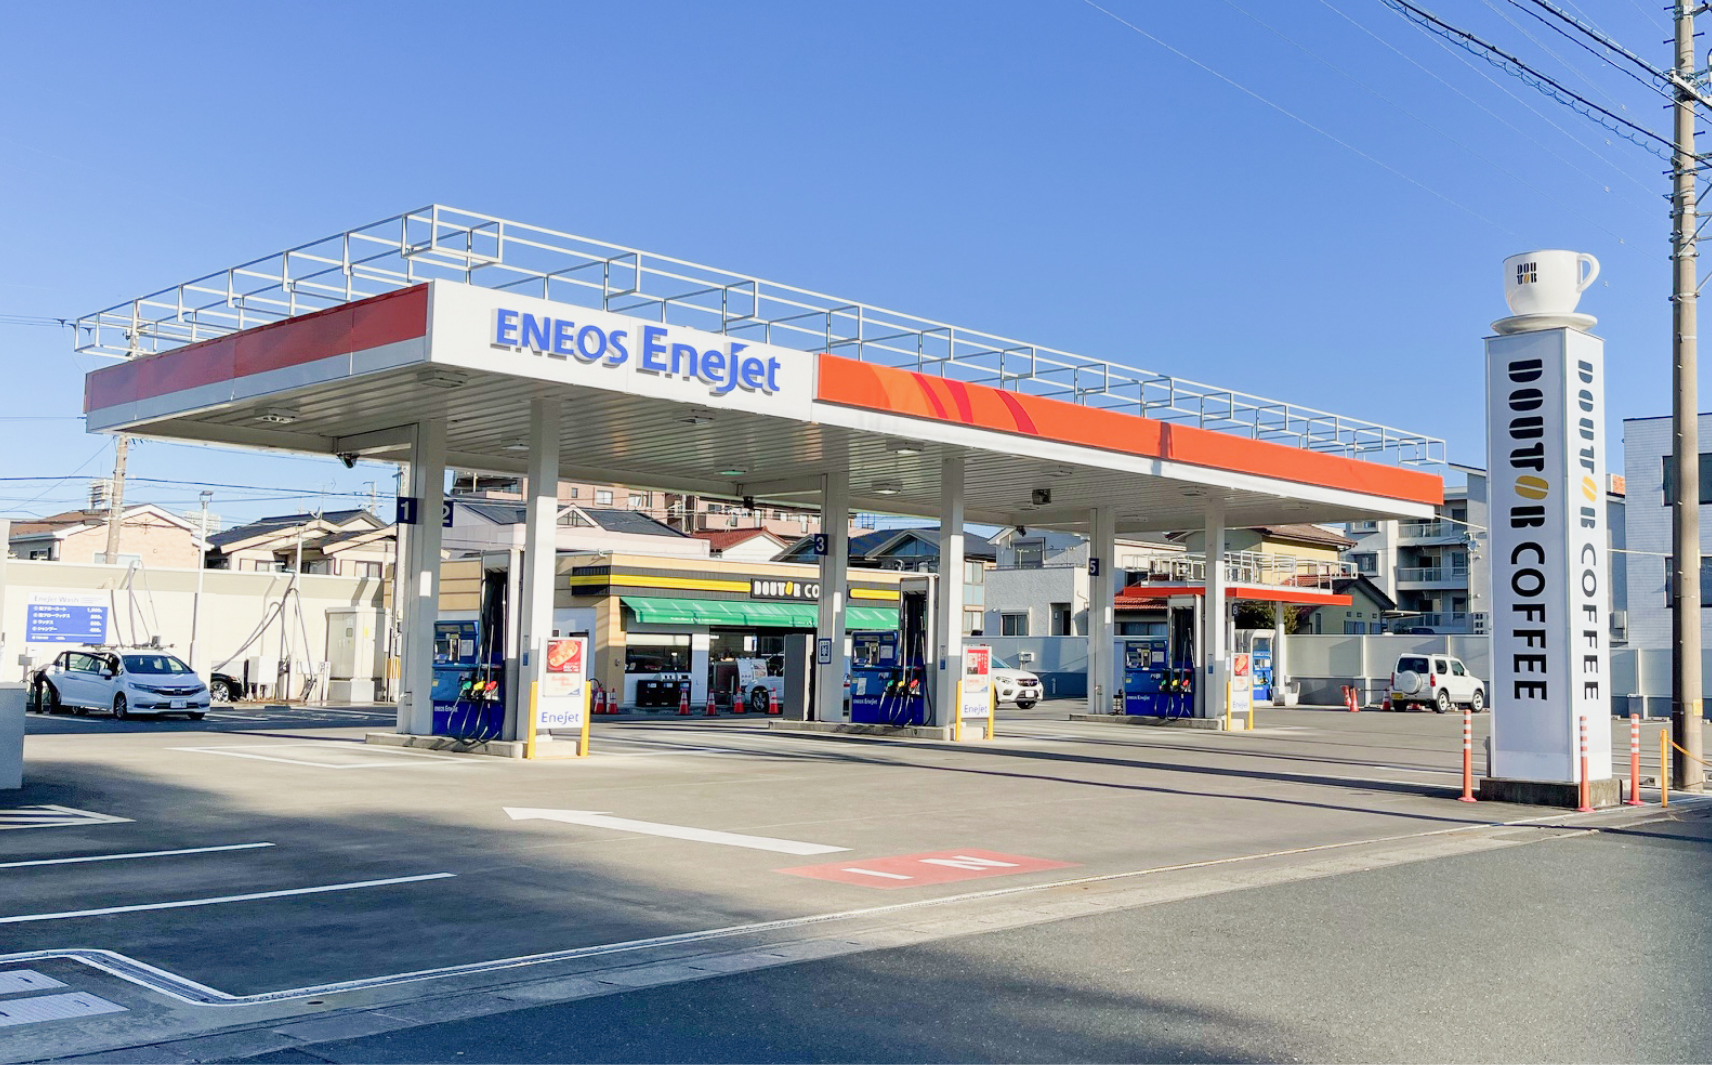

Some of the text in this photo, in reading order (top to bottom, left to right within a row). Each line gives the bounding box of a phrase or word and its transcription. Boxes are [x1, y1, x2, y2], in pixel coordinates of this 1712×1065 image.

[494, 308, 628, 364] ENEOS
[401, 501, 409, 520] 1
[442, 505, 450, 523] 2
[1508, 358, 1549, 701] DOUTOR COFFEE
[1577, 359, 1599, 701] DOUTOR COFFEE
[816, 537, 825, 551] 3
[1089, 560, 1096, 573] 5
[754, 580, 800, 598] DOUTOR
[841, 855, 1021, 881] IN
